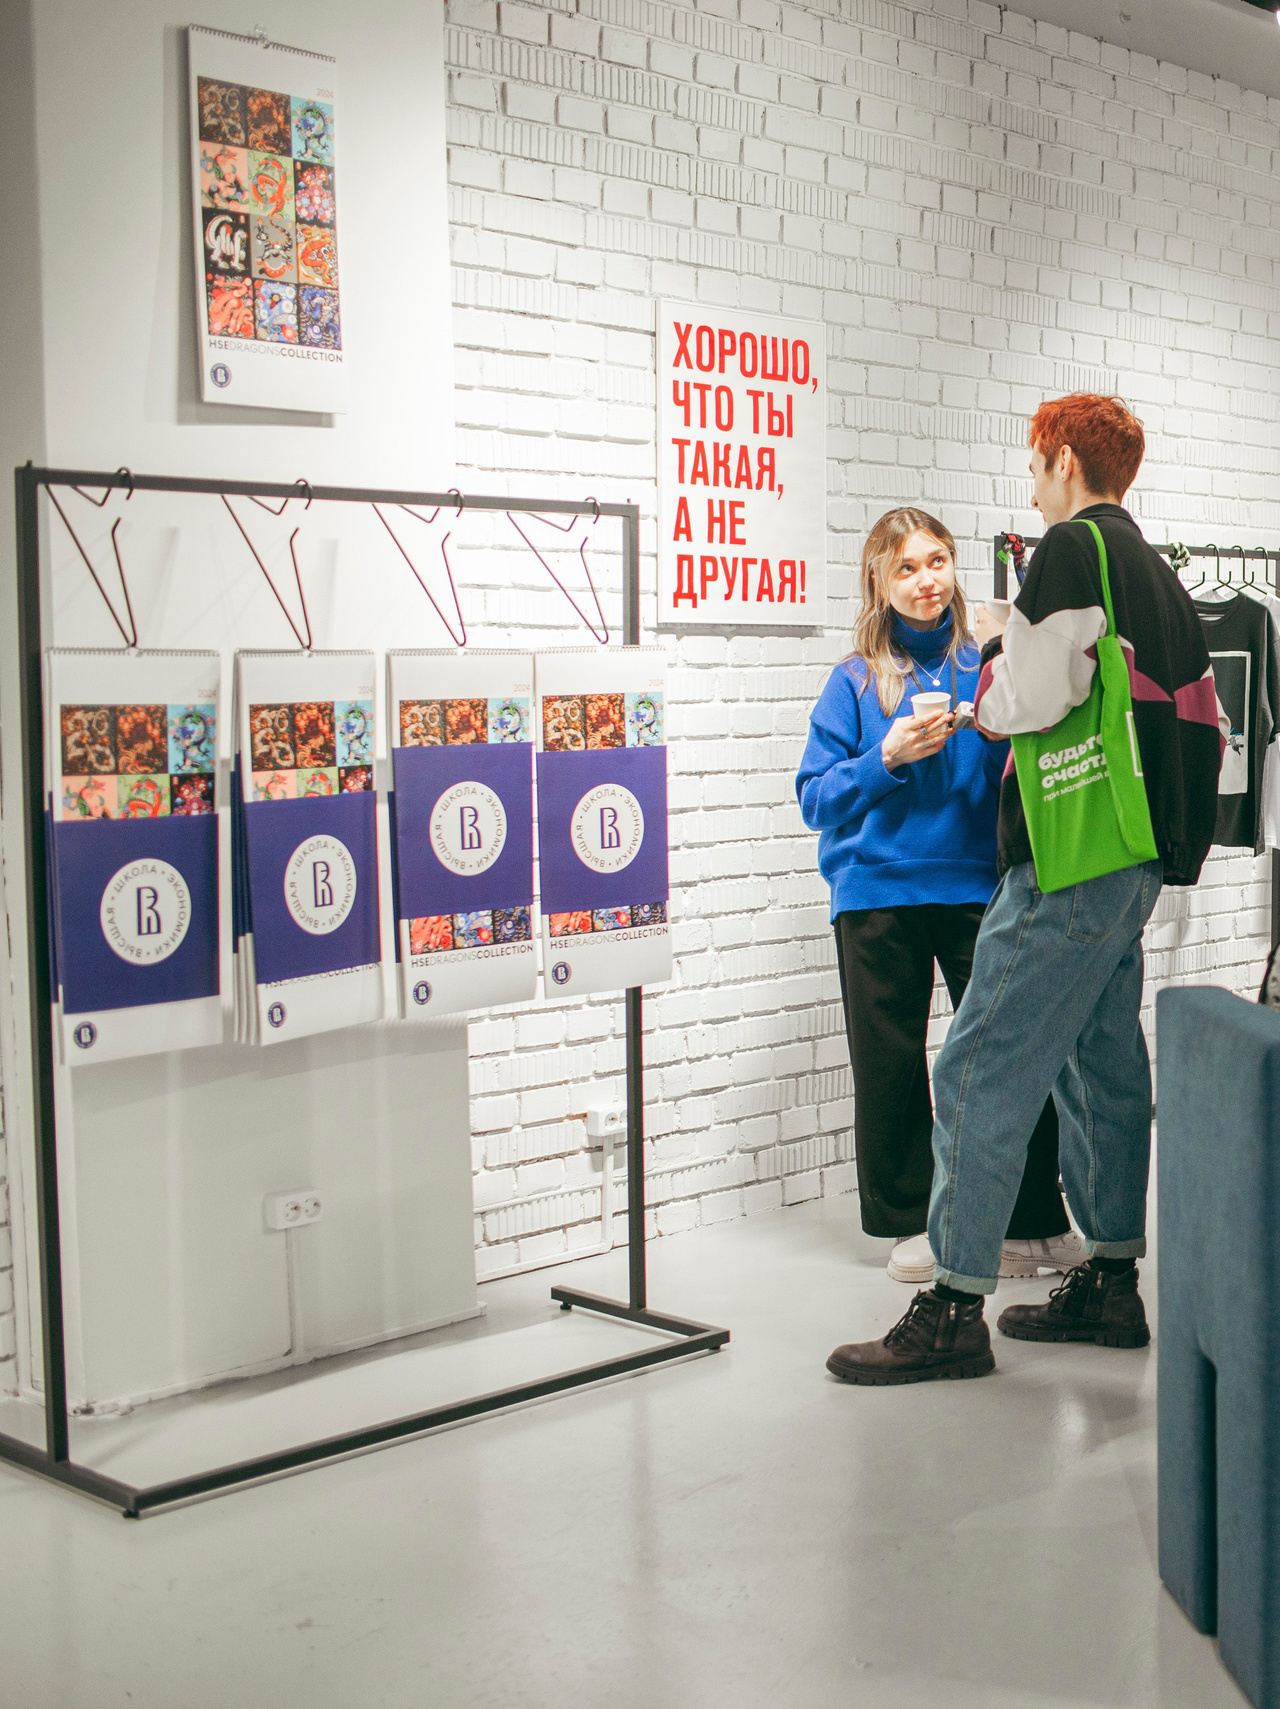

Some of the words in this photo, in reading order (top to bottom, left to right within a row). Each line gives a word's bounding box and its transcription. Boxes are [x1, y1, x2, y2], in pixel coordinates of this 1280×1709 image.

[673, 321, 818, 394] ХОРОШО,
[672, 379, 734, 432] ЧТО
[746, 389, 793, 438] ТЫ
[672, 438, 784, 500] ТАКАЯ,
[673, 496, 693, 542] А
[707, 499, 746, 545] НЕ
[672, 554, 806, 608] ДРУГАЯ!
[441, 786, 478, 812] ШКОЛА
[581, 788, 617, 813] ШКОЛА
[294, 840, 329, 868] ШКОЛА
[435, 824, 467, 870] ВЫСШАЯ
[476, 794, 503, 868] ЭКОНОМИКИ
[576, 824, 606, 867] ВЫСШАЯ
[615, 796, 640, 866] ЭКОНОМИКИ
[113, 864, 157, 892] ШКОЛА
[328, 848, 354, 926] ЭКОНОМИКИ
[155, 873, 187, 956] ЭКОНОМИКИ
[289, 881, 320, 929] ВЫСШАЯ
[106, 907, 142, 958] ВЫСШАЯ
